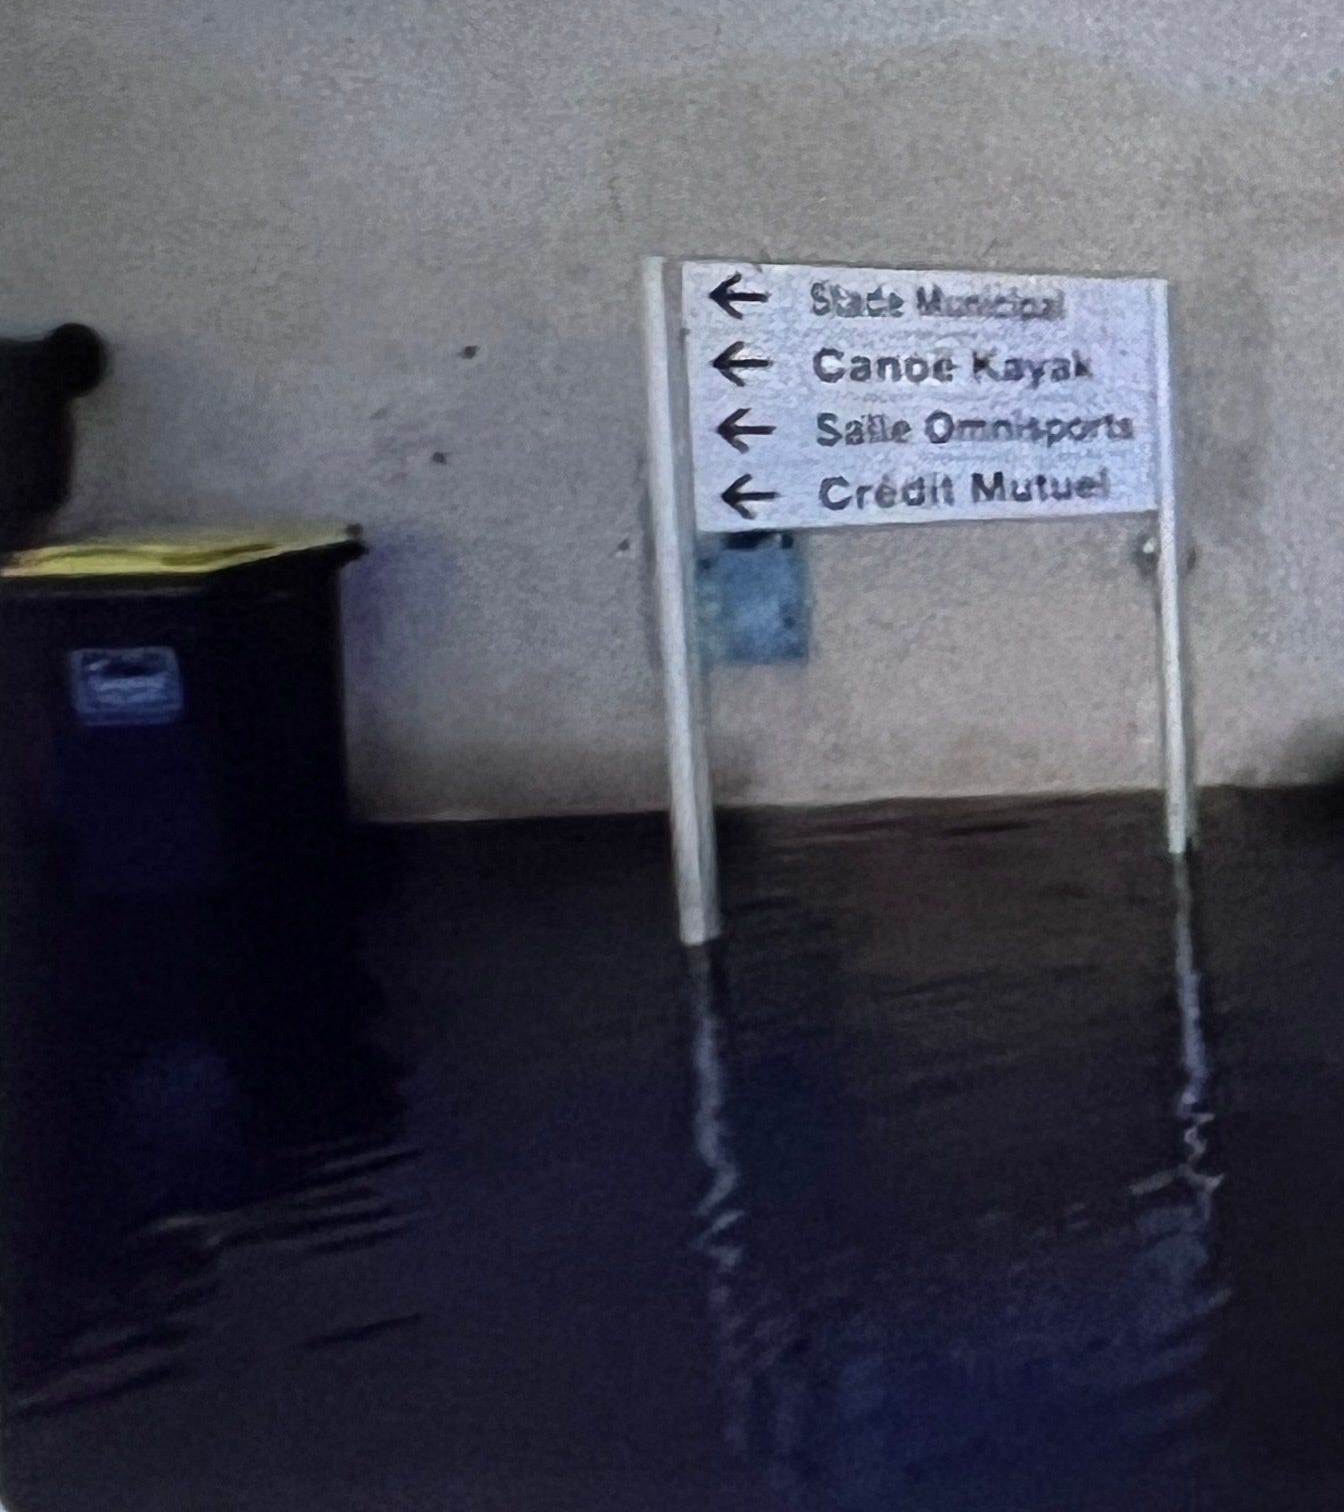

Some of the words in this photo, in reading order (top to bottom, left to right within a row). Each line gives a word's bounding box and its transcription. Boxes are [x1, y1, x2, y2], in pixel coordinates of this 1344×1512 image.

[809, 280, 905, 319] Stade
[812, 348, 955, 384] Canoe
[971, 349, 1095, 388] Kayak
[815, 412, 911, 447] Salle
[818, 473, 956, 511] Crédit
[970, 469, 1111, 506] Mutuel
